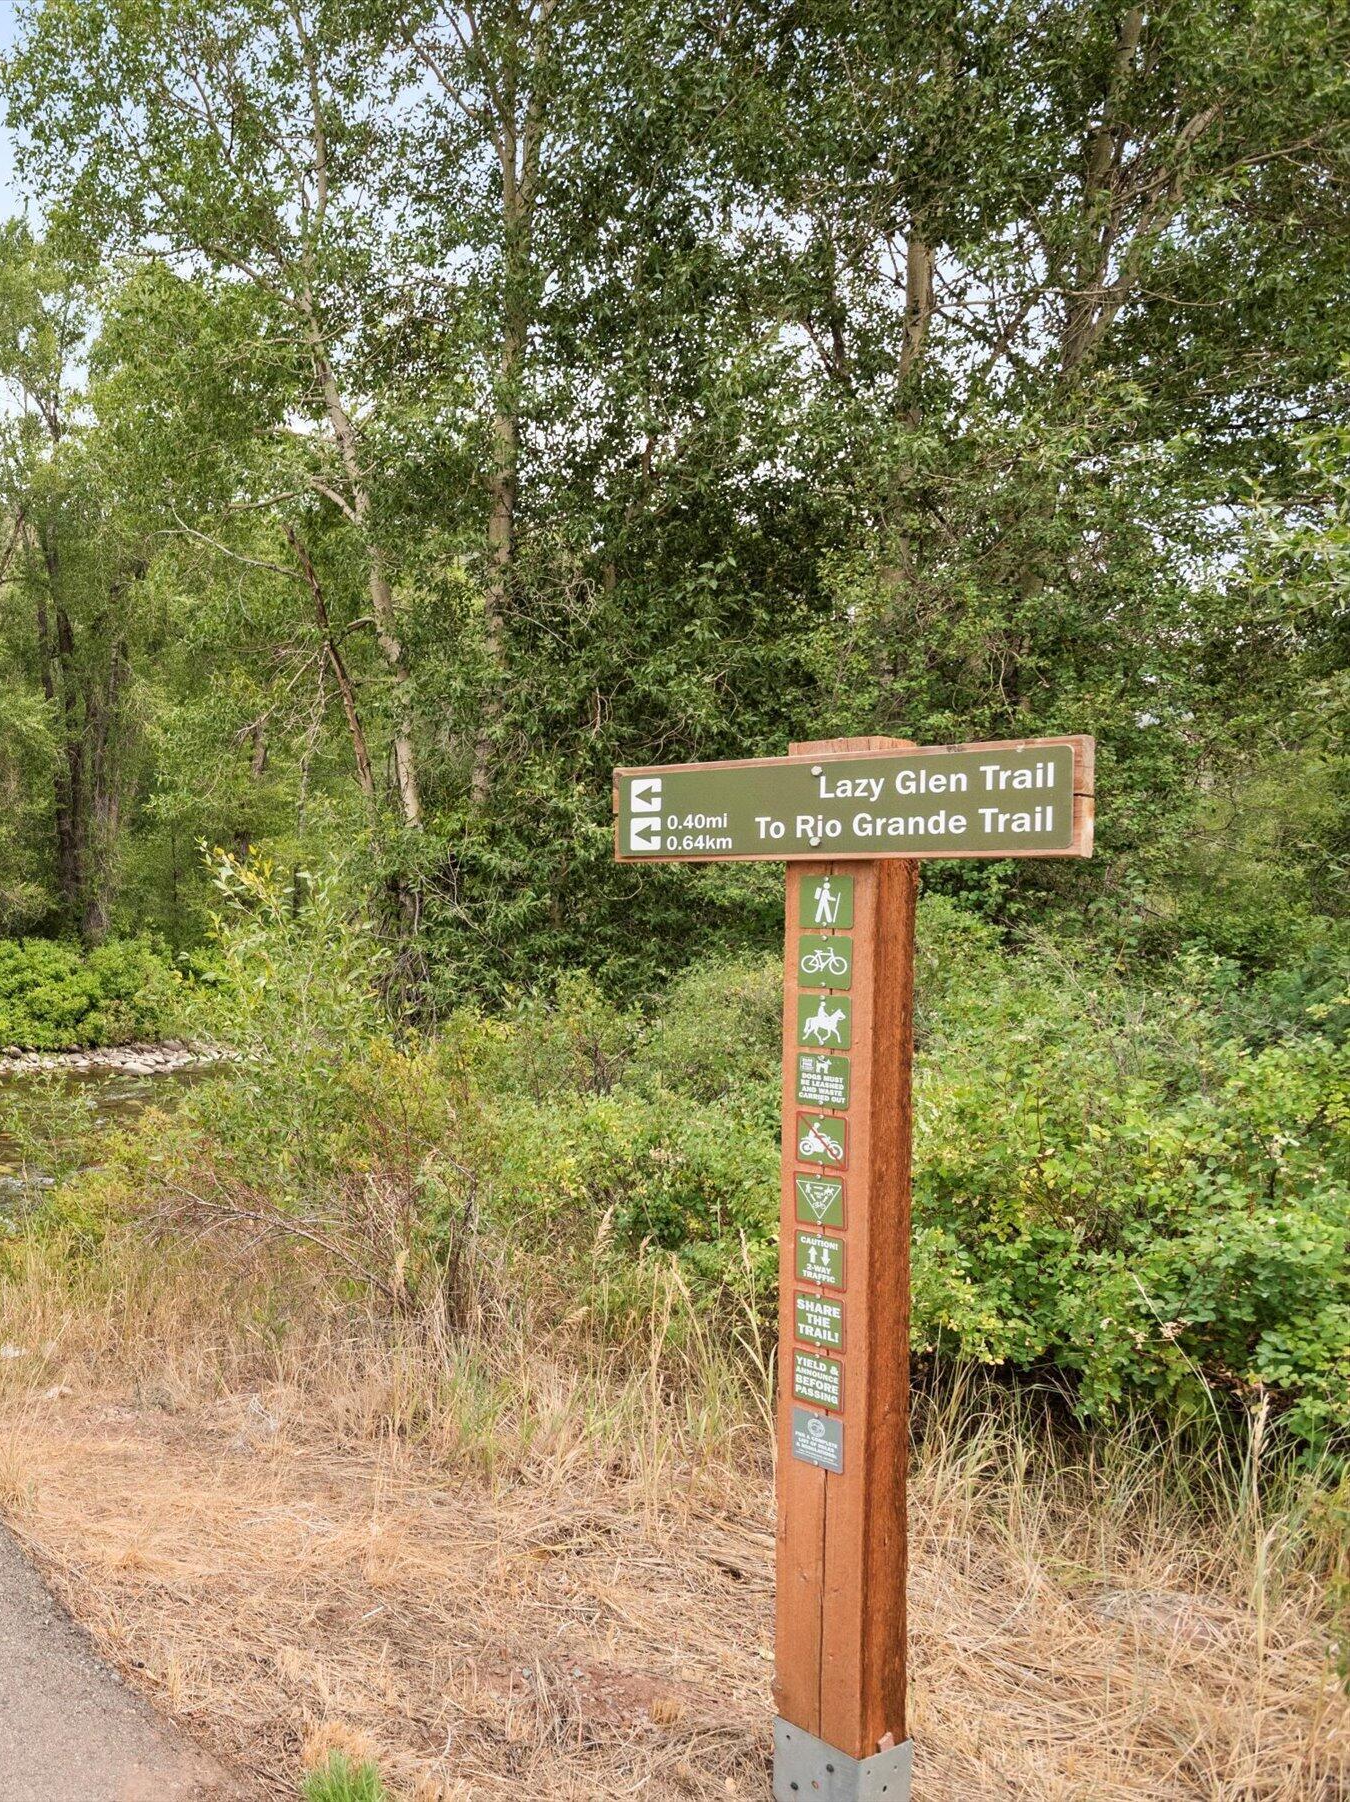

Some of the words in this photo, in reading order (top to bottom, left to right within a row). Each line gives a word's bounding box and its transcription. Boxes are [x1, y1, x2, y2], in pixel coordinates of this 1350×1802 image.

[819, 775, 885, 802] Lazy
[895, 769, 967, 795] Glen
[979, 762, 1055, 790] Trail
[667, 812, 728, 831] 0.40mi
[755, 816, 785, 839] To
[795, 813, 842, 838] Rio
[853, 810, 967, 838] Grande
[978, 806, 1054, 833] Trail
[667, 833, 732, 851] 0.64km
[802, 1072, 821, 1081] DOGS
[823, 1075, 843, 1083] MUST
[811, 1080, 844, 1090] LEASHED
[798, 1092, 830, 1101] CARRIED
[818, 1088, 842, 1096] WASTE
[800, 1236, 838, 1250] CAUTION!
[802, 1269, 836, 1283] TRAFFIC
[806, 1263, 831, 1274] 2-WAY
[796, 1298, 841, 1319] SHARE
[805, 1313, 831, 1328] THE
[798, 1323, 839, 1343] TRAIL!
[795, 1355, 827, 1372] YIELD
[830, 1365, 838, 1376] &
[796, 1366, 838, 1384] ANNOUNCE
[796, 1374, 838, 1395] BEFORE
[795, 1384, 838, 1405] PASSING
